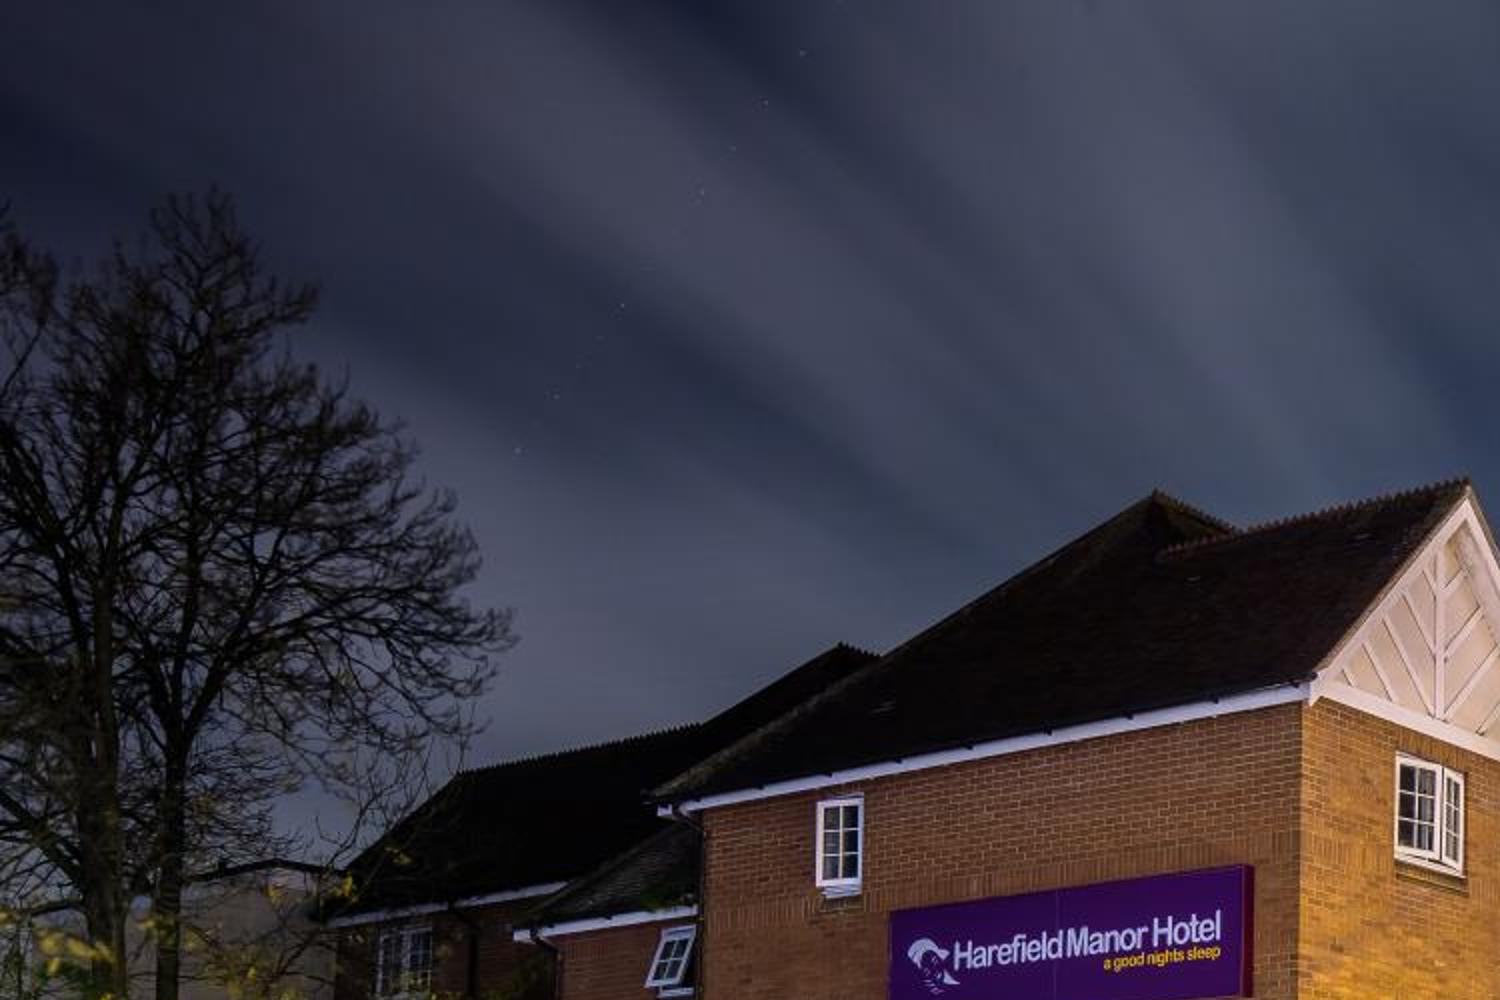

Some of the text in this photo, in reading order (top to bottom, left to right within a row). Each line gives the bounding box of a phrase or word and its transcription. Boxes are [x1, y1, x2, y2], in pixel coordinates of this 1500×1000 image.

[953, 909, 1222, 970] Harefield Manor Hotel
[1103, 945, 1221, 973] a good nights sleep
